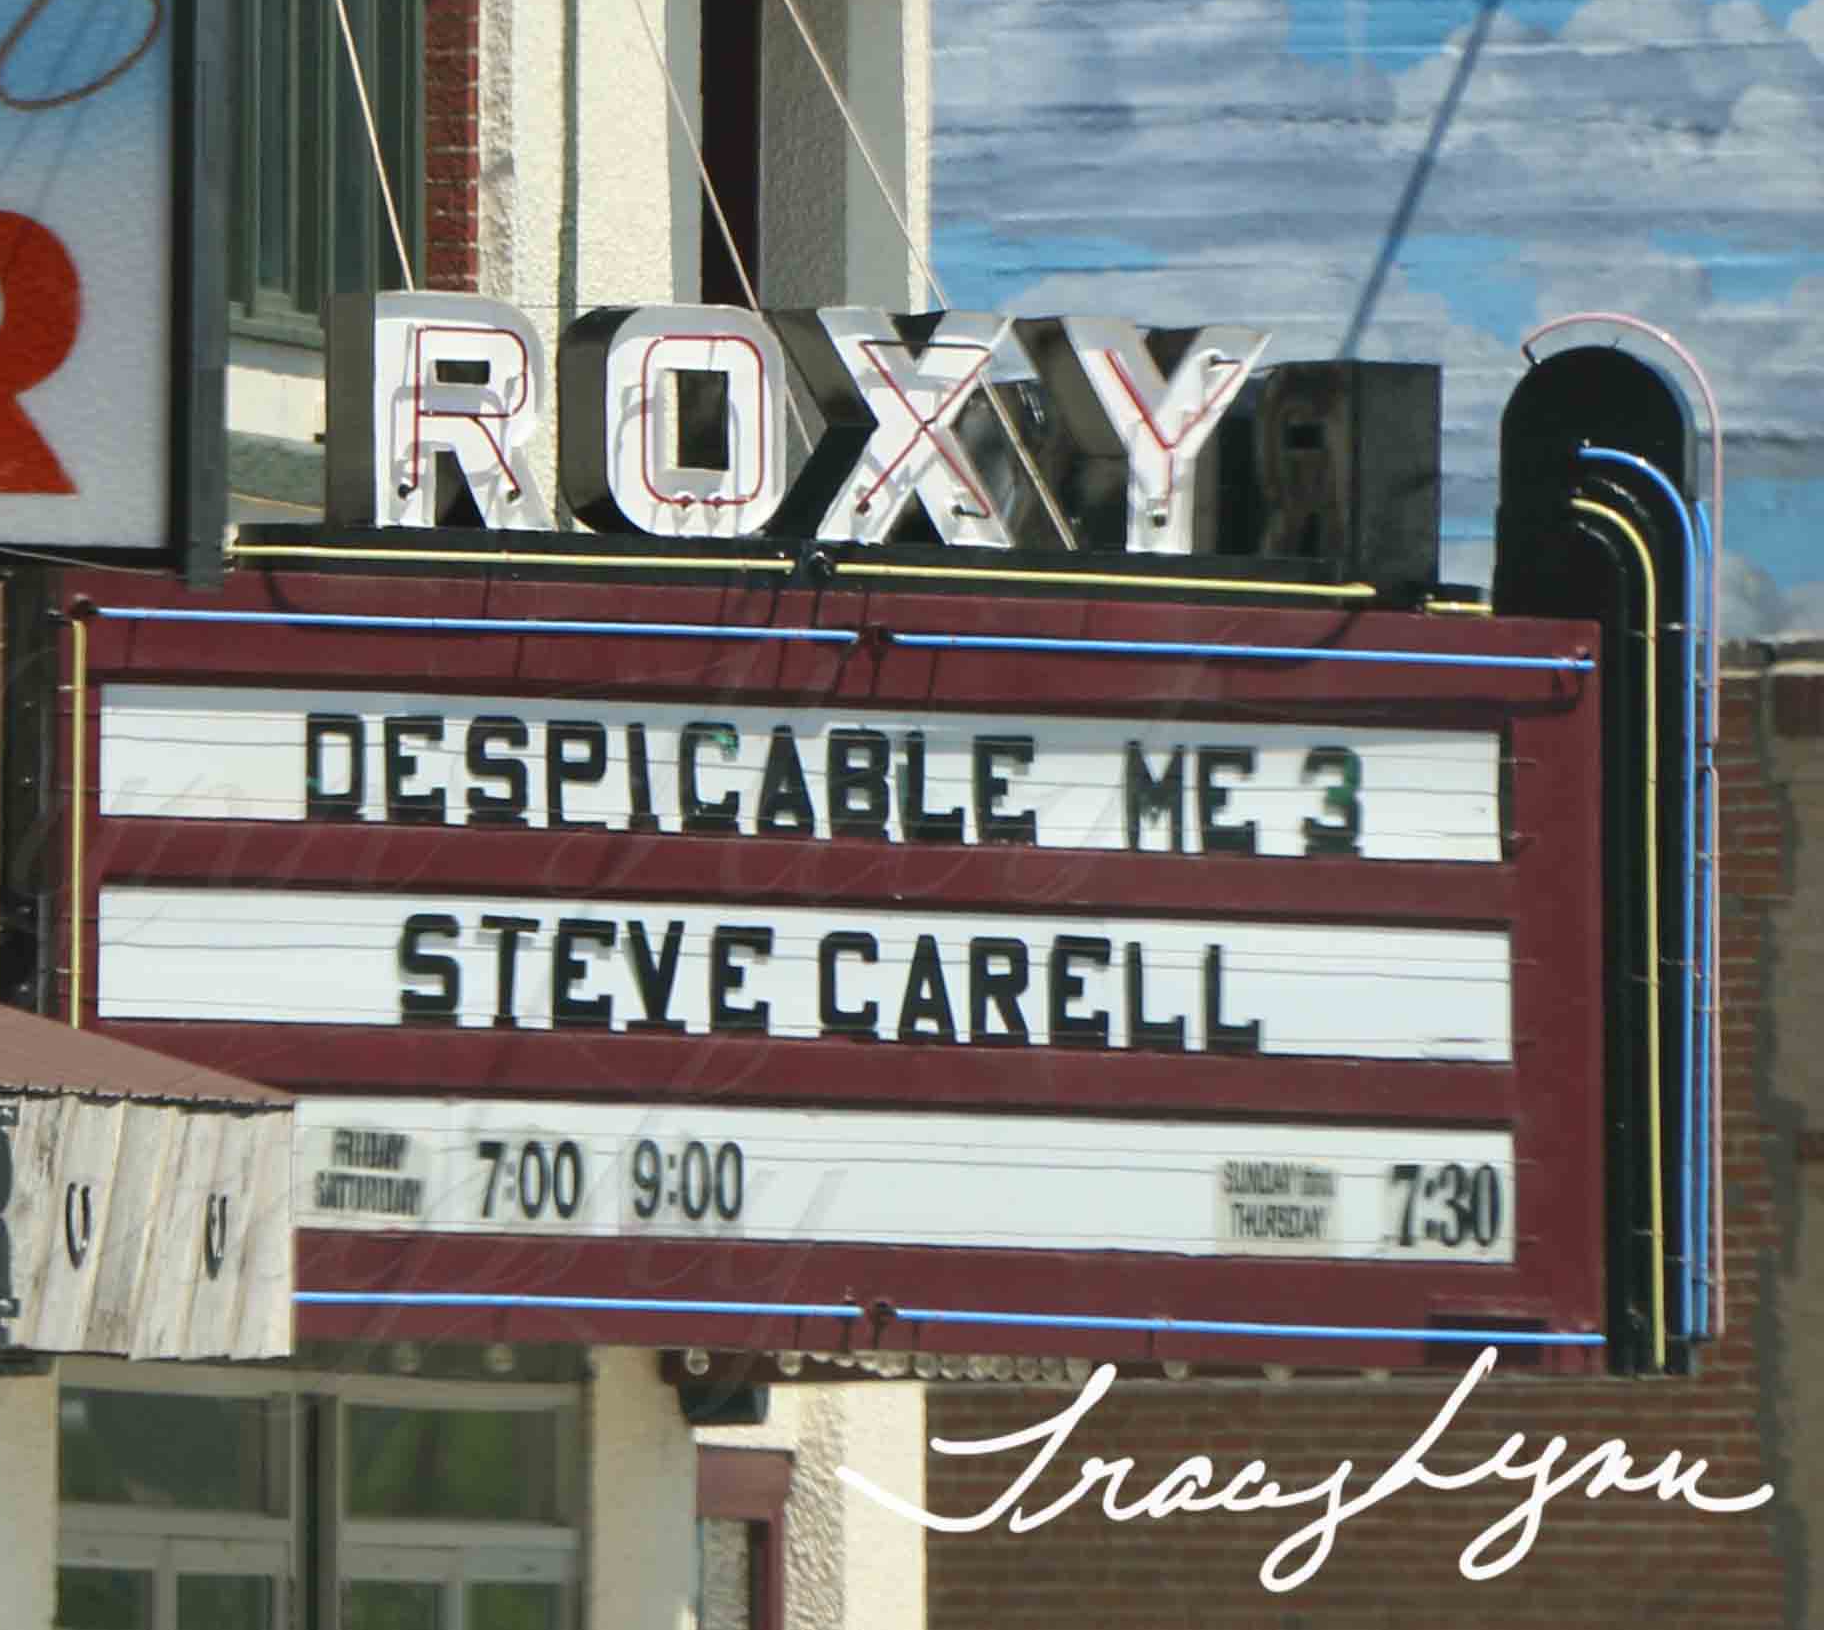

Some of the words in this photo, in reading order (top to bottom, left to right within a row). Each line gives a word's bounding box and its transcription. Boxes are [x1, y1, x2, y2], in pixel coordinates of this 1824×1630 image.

[366, 293, 1272, 553] ROXY
[305, 712, 1037, 845] DESPICABLE
[1124, 740, 1259, 856] ME
[1303, 748, 1364, 857] 3
[398, 912, 775, 1033] STEVE
[818, 930, 1263, 1055] CARELL
[478, 1139, 584, 1220] 7:00
[633, 1138, 744, 1221] 9:00
[1389, 1163, 1501, 1248] 7:30
